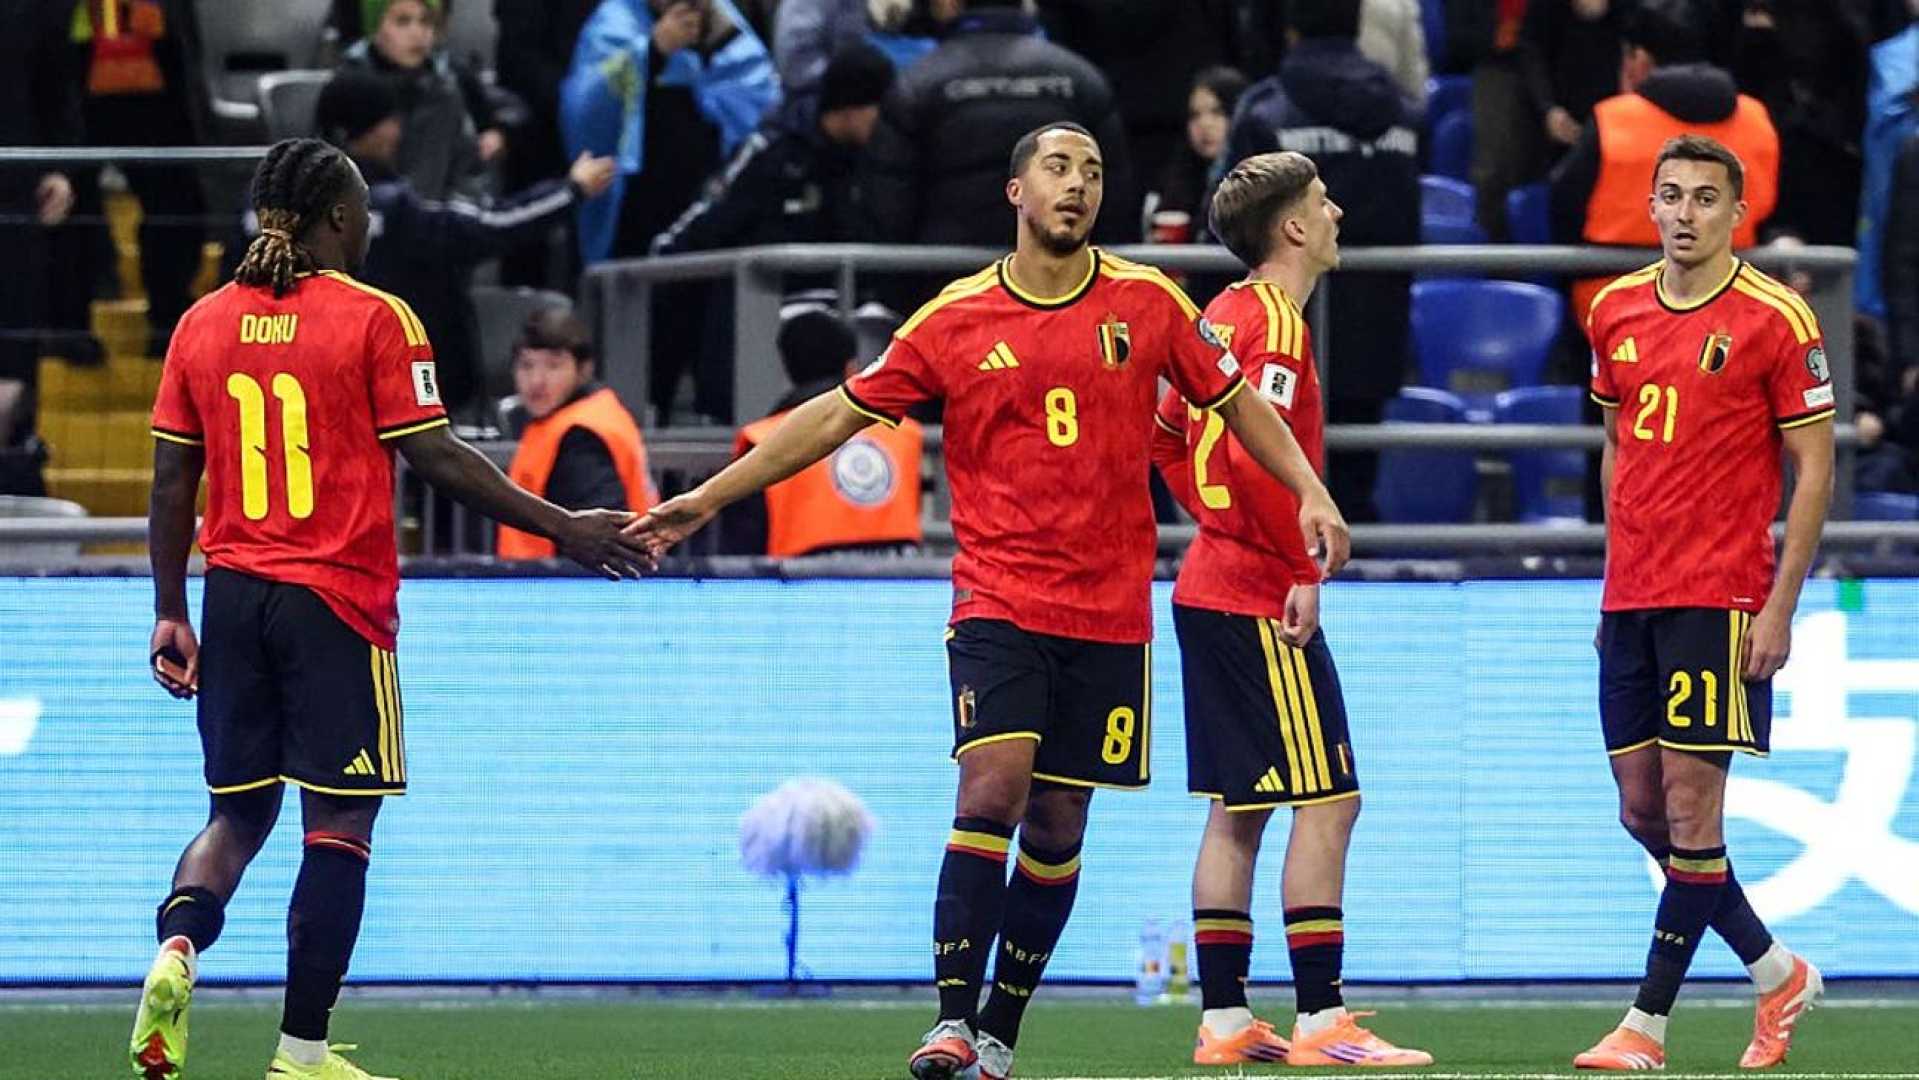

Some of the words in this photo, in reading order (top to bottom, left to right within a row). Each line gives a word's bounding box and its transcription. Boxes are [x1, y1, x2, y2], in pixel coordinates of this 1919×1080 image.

[241, 315, 297, 344] DOKU
[1045, 387, 1078, 447] 8
[1634, 384, 1678, 442] 21
[227, 373, 313, 520] 11
[1667, 671, 1716, 726] 21
[1102, 707, 1134, 764] 8
